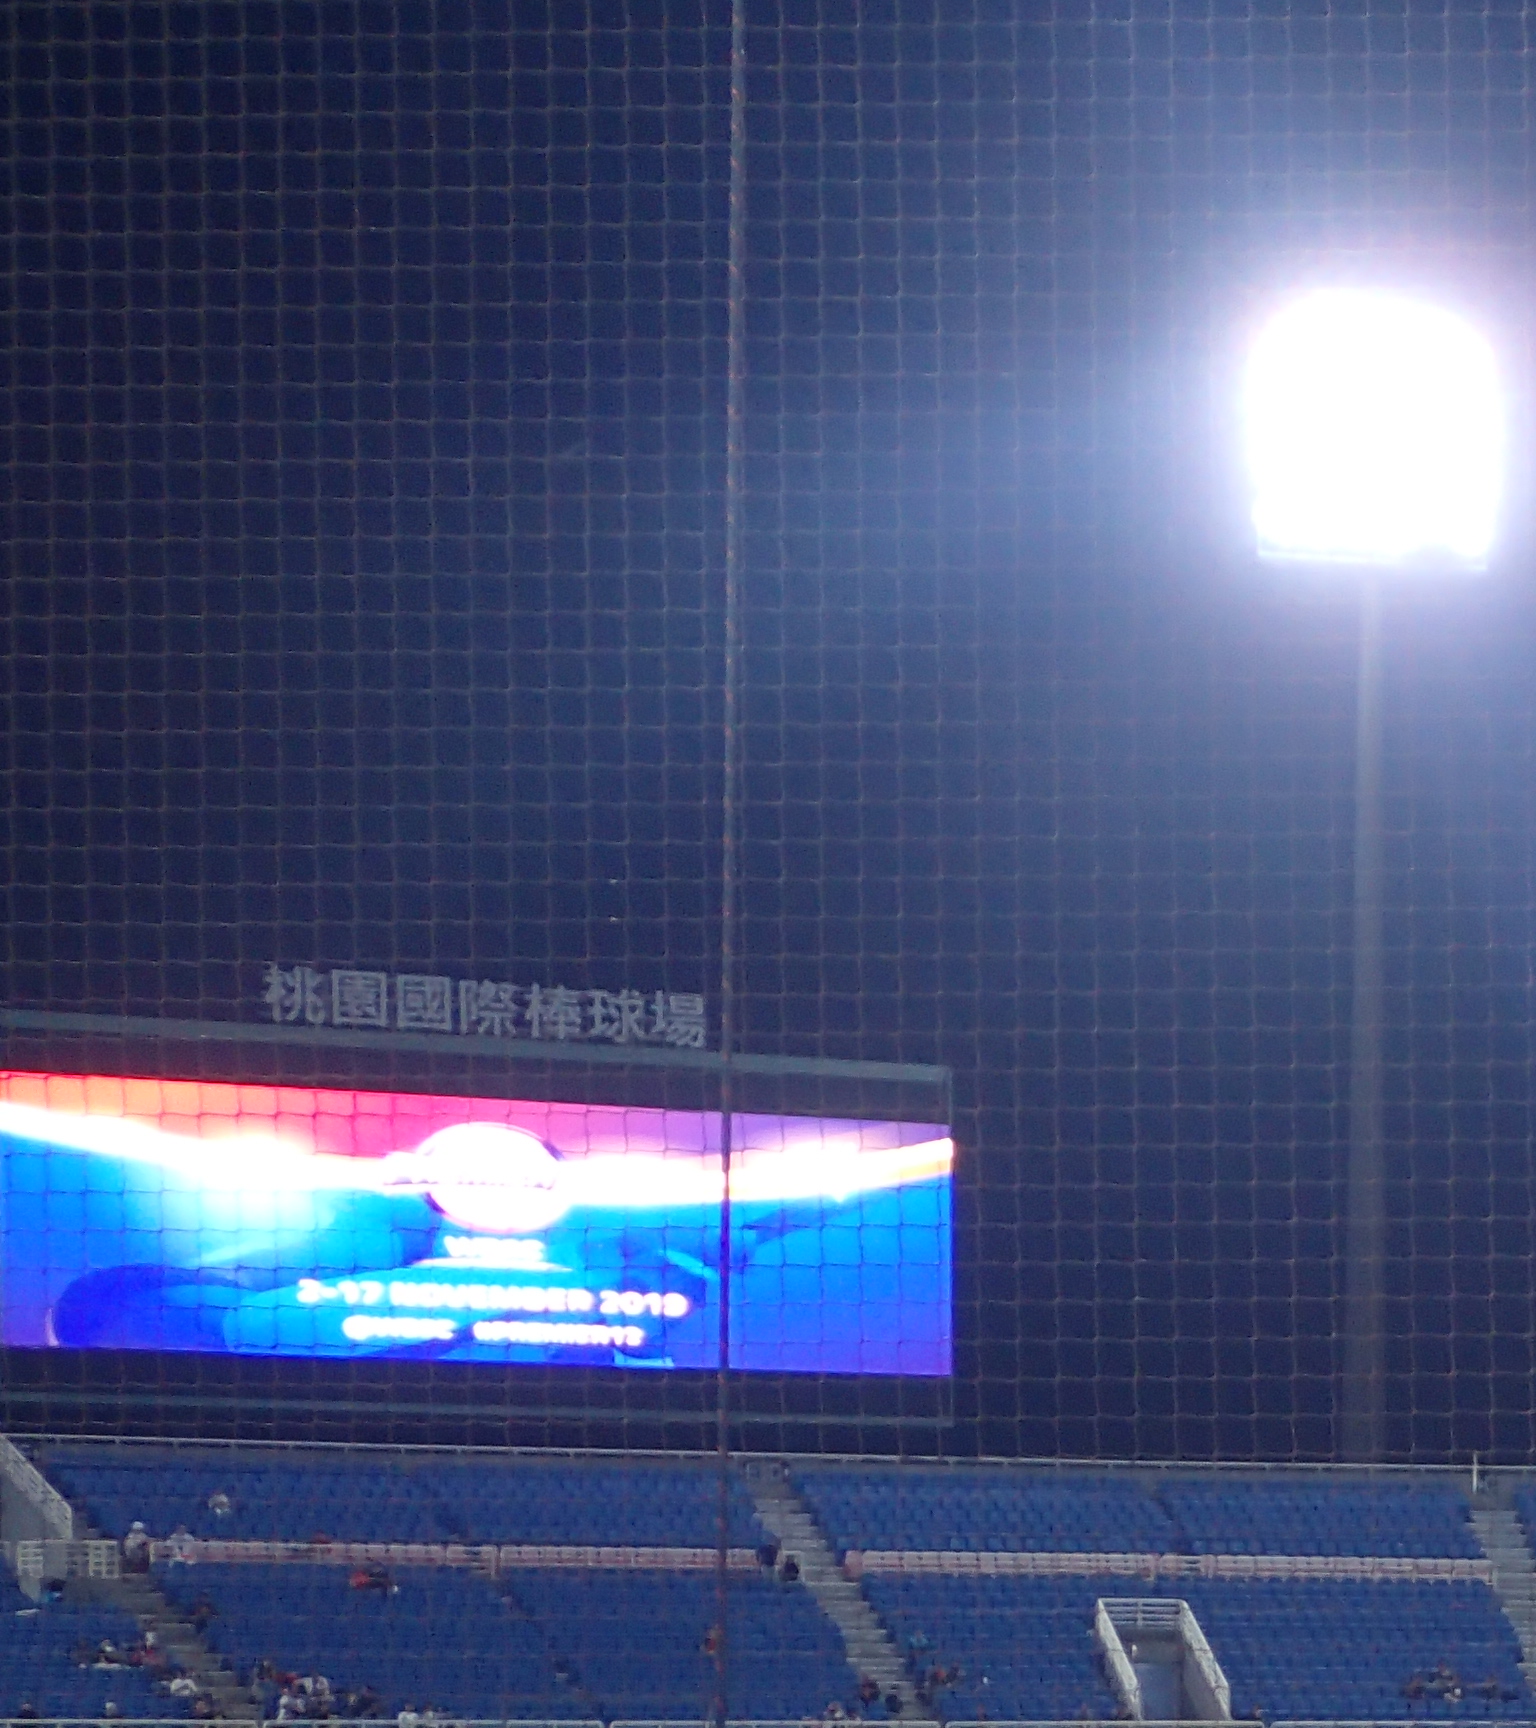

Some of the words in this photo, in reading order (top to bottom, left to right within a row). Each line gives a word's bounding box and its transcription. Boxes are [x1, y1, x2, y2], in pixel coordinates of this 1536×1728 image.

[264, 963, 706, 1049] 桃園國際棒球場
[389, 1282, 594, 1312] NOVEMBER
[599, 1290, 689, 1318] 2019
